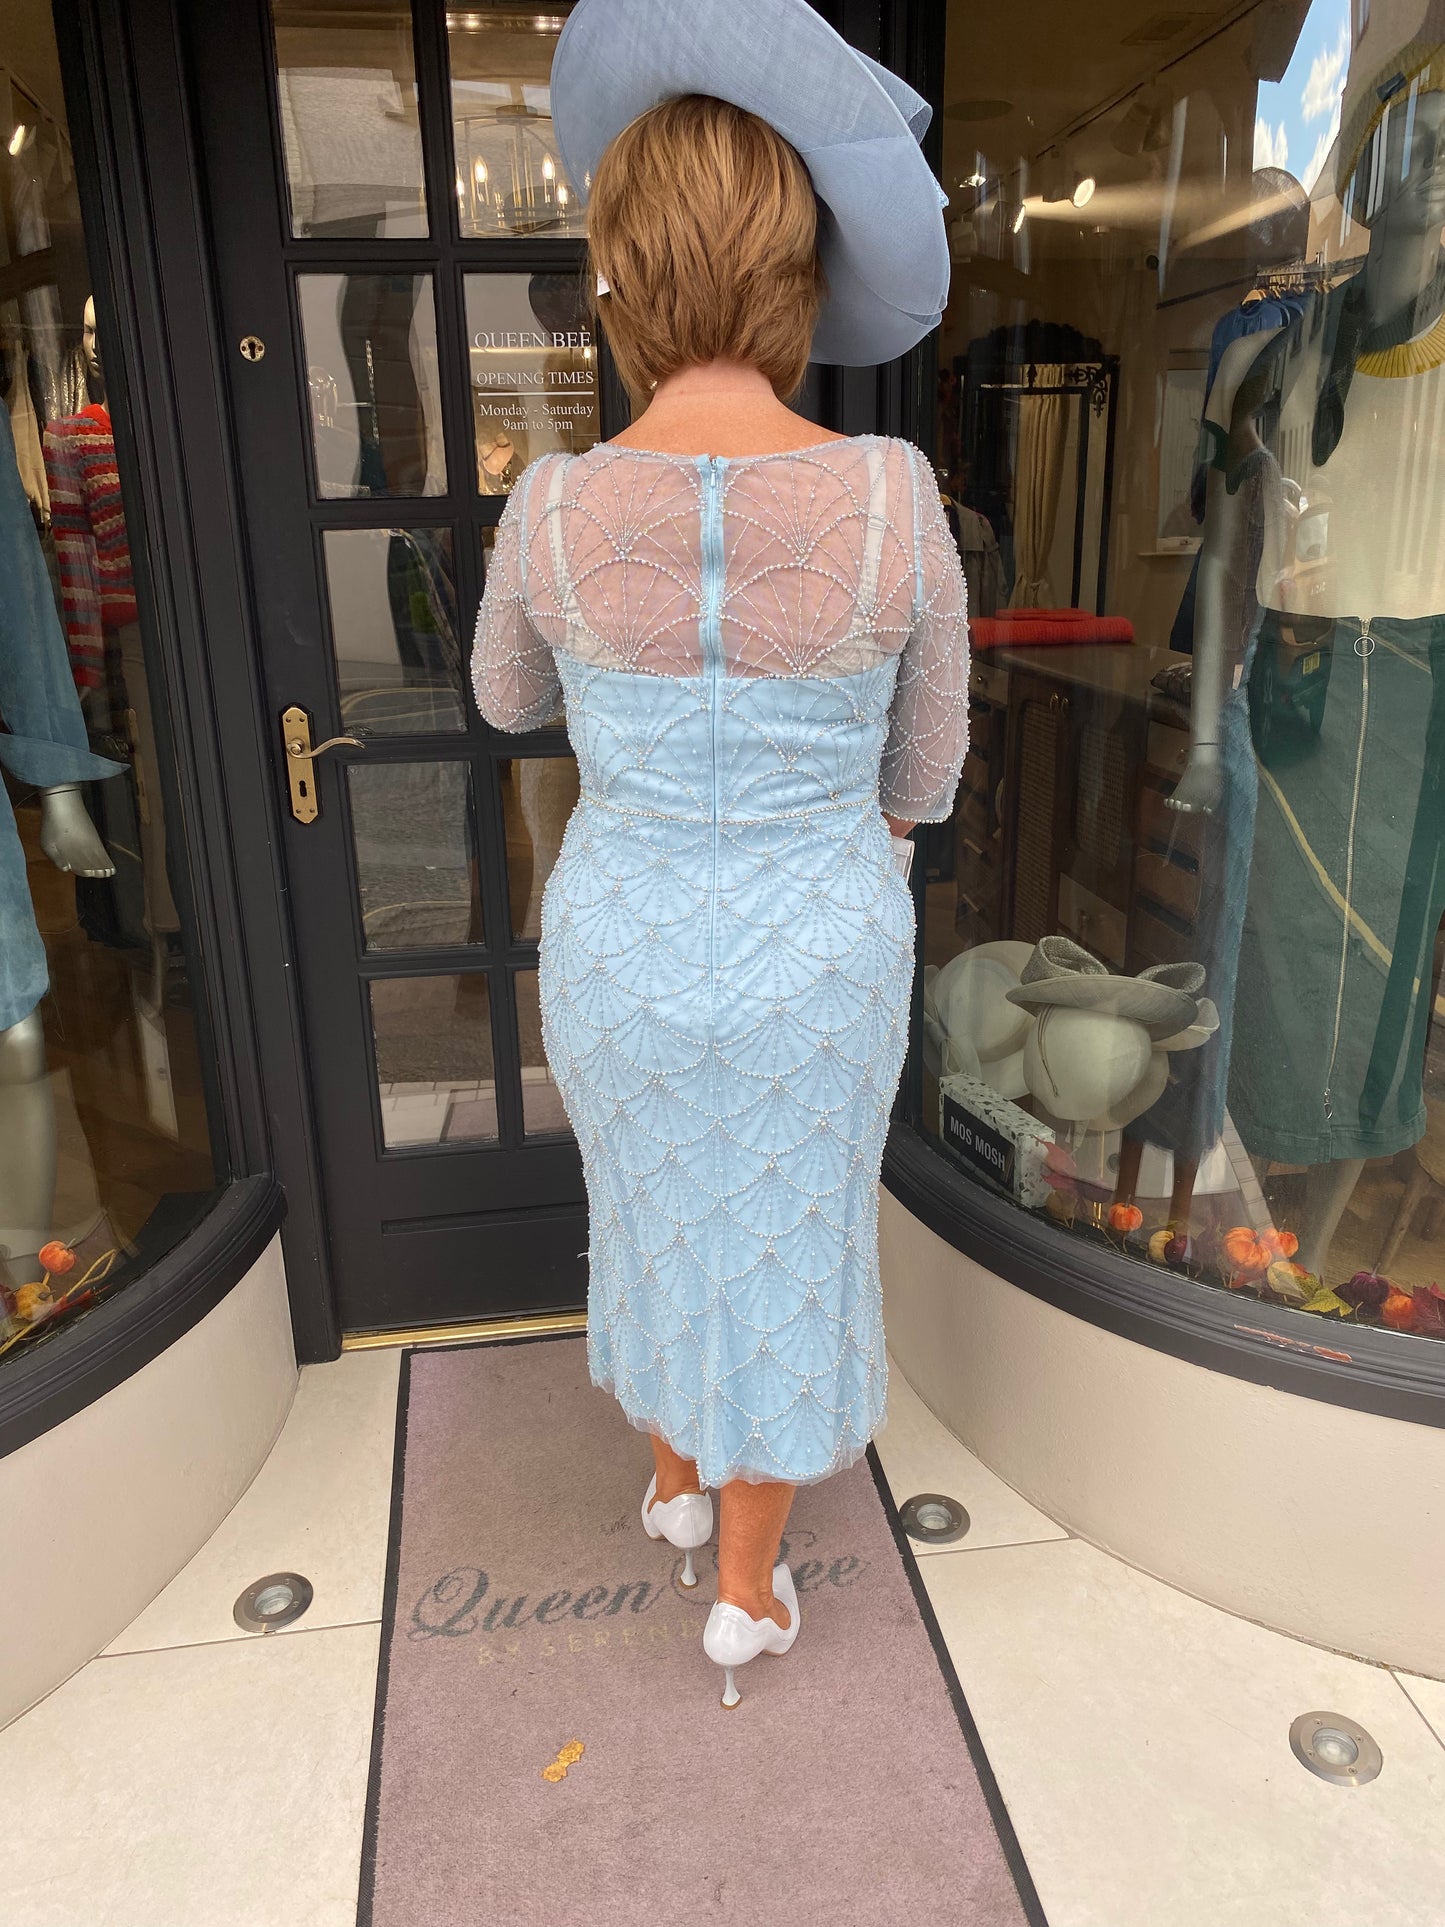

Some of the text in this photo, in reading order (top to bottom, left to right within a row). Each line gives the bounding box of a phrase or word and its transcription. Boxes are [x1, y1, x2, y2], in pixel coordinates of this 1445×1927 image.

[474, 332, 592, 352] QUEEN BEE
[476, 371, 594, 385] OPENING TIMES
[480, 403, 529, 418] Monday
[542, 403, 594, 418] Saturday
[502, 418, 574, 432] 9am to 5pm
[950, 1115, 1006, 1171] MOS MOSH
[406, 1565, 662, 1642] Queen
